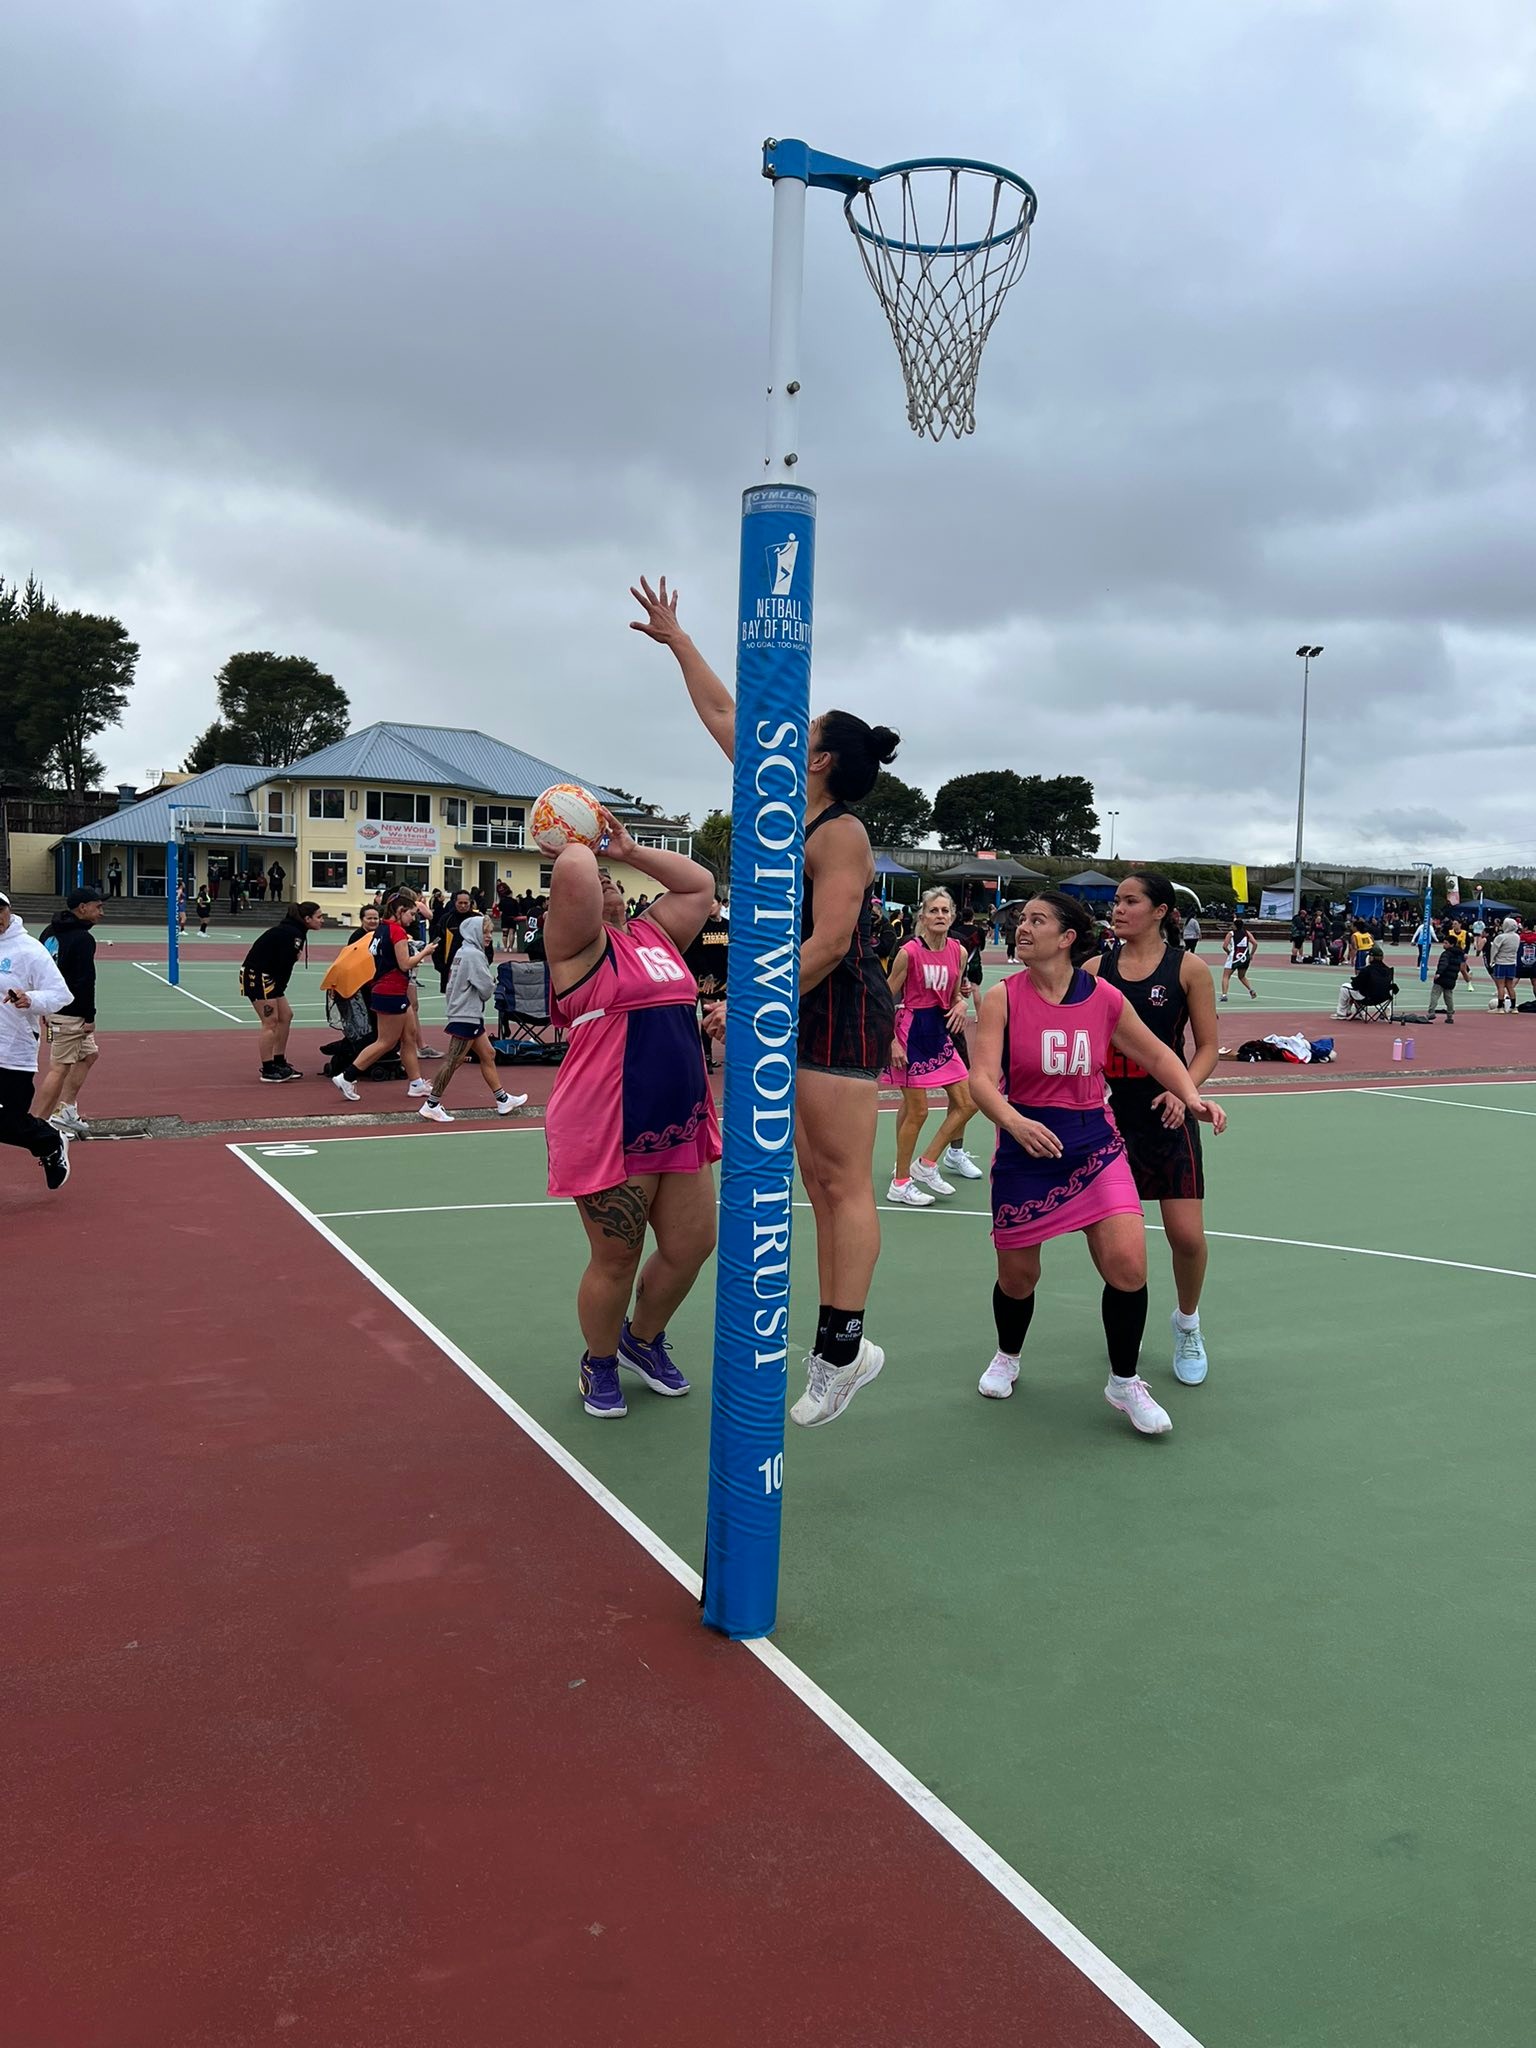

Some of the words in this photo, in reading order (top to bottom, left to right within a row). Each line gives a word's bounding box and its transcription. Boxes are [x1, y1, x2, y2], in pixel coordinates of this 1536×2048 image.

[756, 598, 802, 620] NETBALL
[742, 620, 760, 641] BAY
[764, 619, 778, 639] OF
[381, 824, 402, 832] NEW
[403, 825, 435, 834] WORLD
[388, 831, 428, 839] Westend
[753, 720, 799, 1150] SCOTTWOOD
[634, 946, 686, 982] GS
[923, 964, 949, 991] WA
[1041, 1029, 1092, 1077] GA
[752, 1176, 791, 1372] TRUST
[758, 1452, 783, 1495] 10
